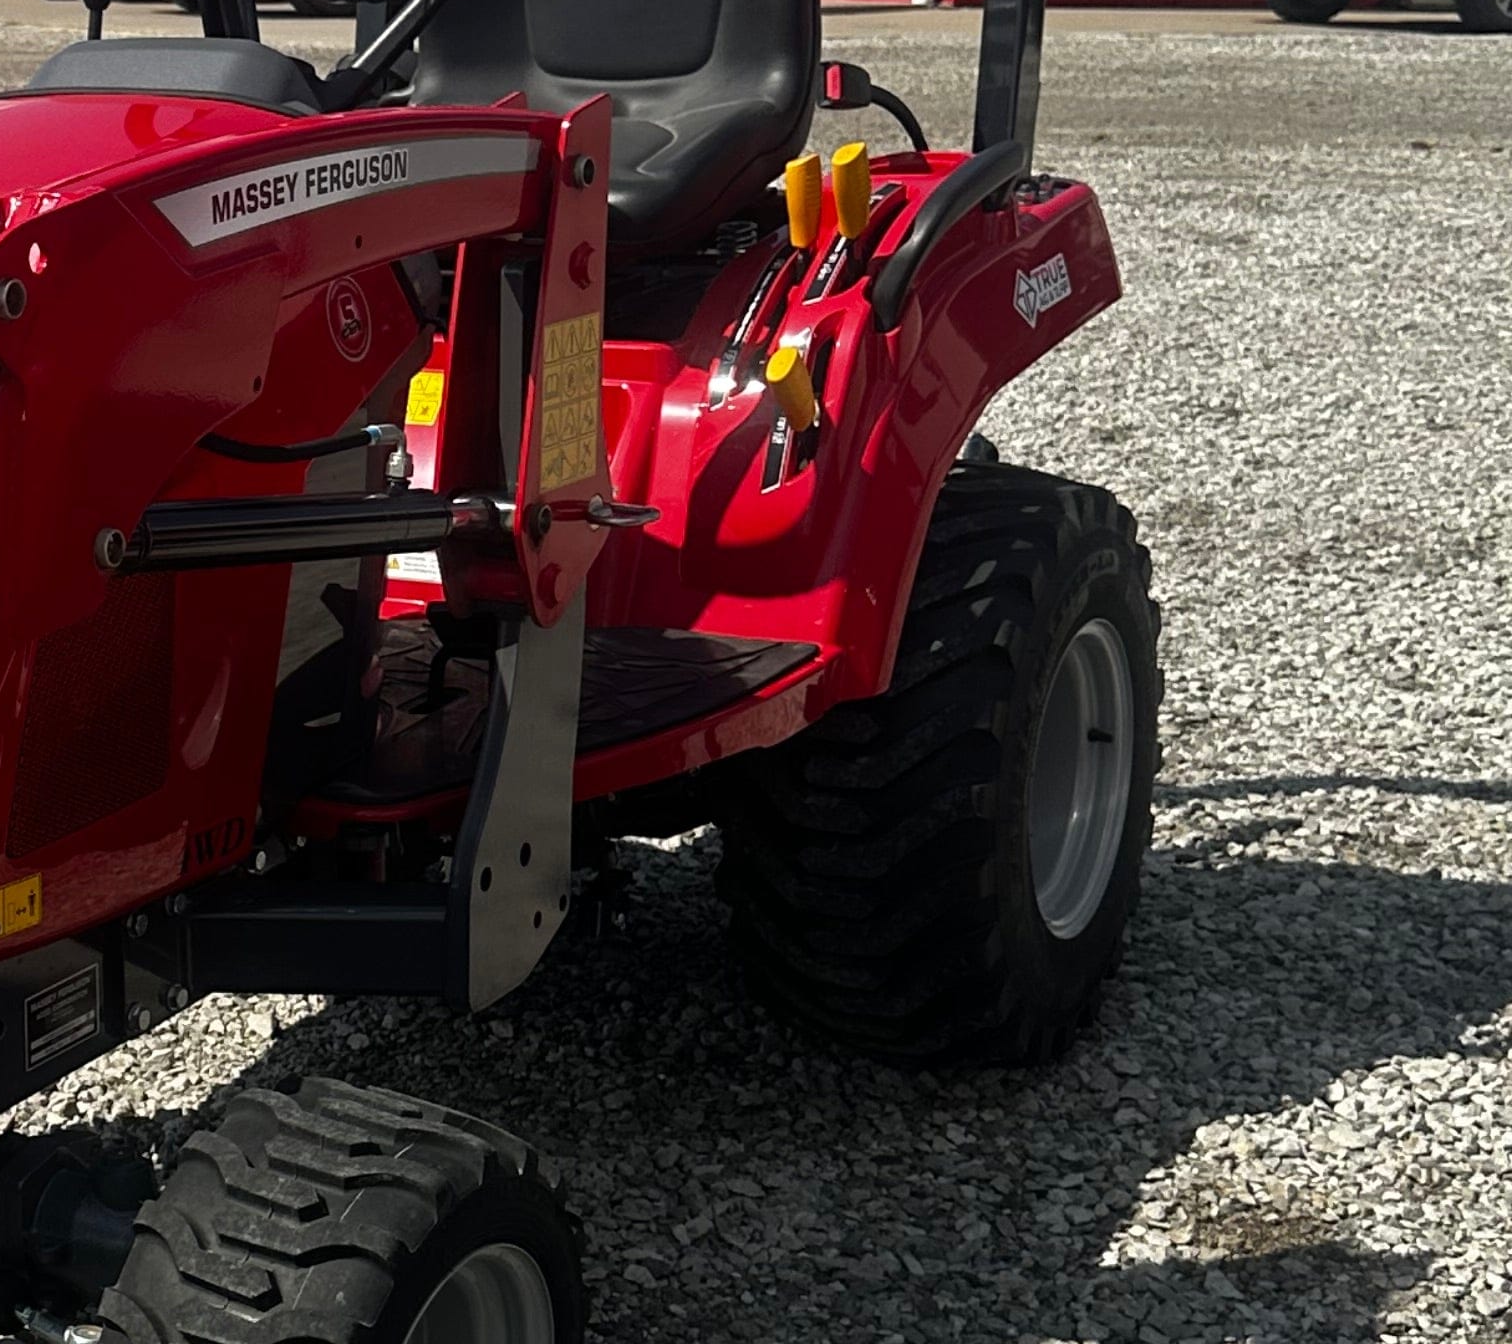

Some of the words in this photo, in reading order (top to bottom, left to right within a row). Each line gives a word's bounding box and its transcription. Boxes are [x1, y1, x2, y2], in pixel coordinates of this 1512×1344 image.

[211, 171, 299, 225] MASSEY
[305, 151, 408, 198] FERGUSON
[1033, 257, 1066, 293] TRUE
